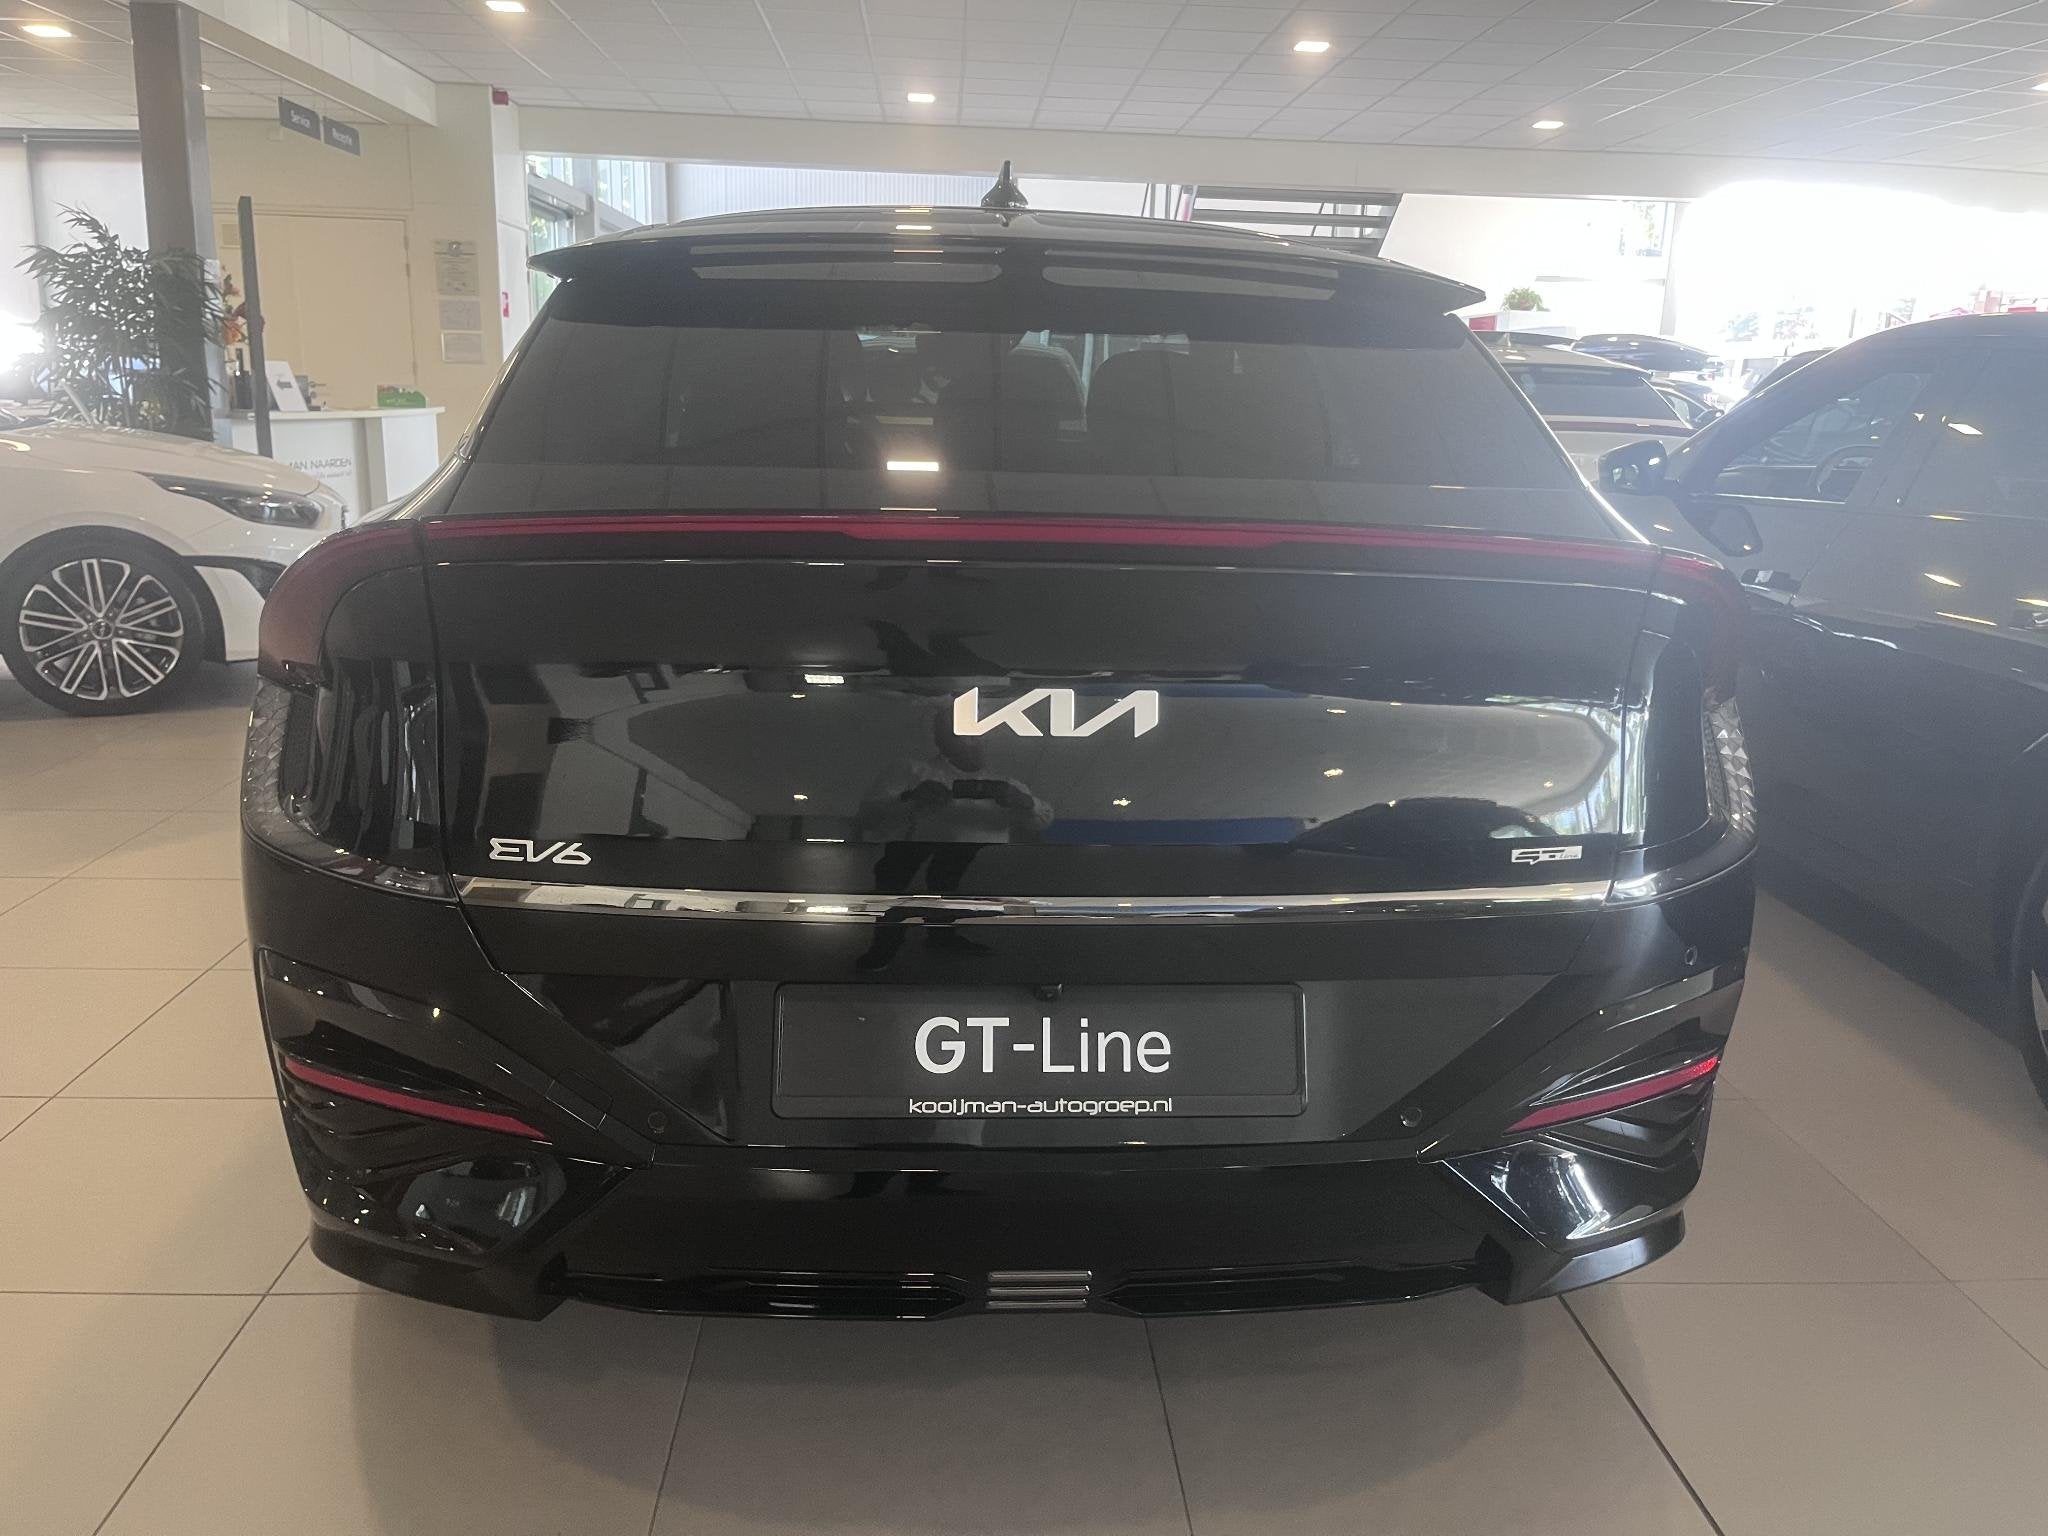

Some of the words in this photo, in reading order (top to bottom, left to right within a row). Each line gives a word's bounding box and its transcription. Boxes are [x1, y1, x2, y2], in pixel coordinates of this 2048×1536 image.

[310, 457, 352, 469] NAARDEN
[953, 686, 1159, 738] KIA
[489, 837, 592, 865] EV6
[914, 1016, 1171, 1074] GT-Line
[908, 1098, 1173, 1116] kooijman-autogroep.nl
